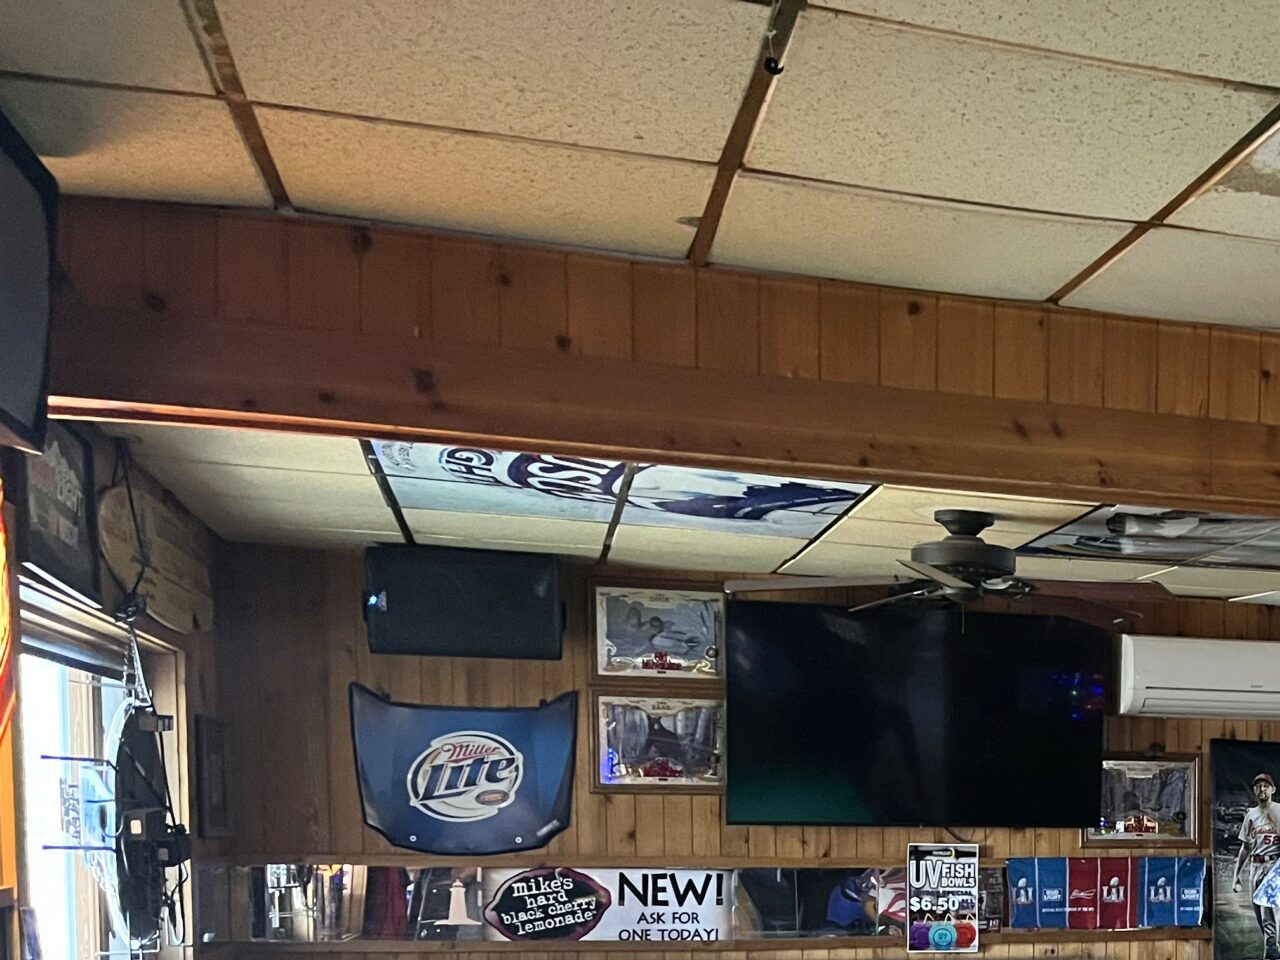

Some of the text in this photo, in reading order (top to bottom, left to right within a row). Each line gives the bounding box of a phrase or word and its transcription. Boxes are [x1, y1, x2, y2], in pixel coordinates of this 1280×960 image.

[441, 741, 501, 763] Miller
[416, 757, 517, 802] Lite
[909, 860, 975, 889] UV FISH
[941, 877, 976, 887] BOWLS
[512, 876, 574, 898] mike's
[618, 872, 724, 907] NEW!
[501, 896, 597, 925] black cherry
[524, 890, 568, 909] hard
[909, 896, 960, 912] $6.50
[516, 911, 593, 935] lemonade
[637, 911, 700, 925] ASK FOR
[618, 929, 651, 941] ONE
